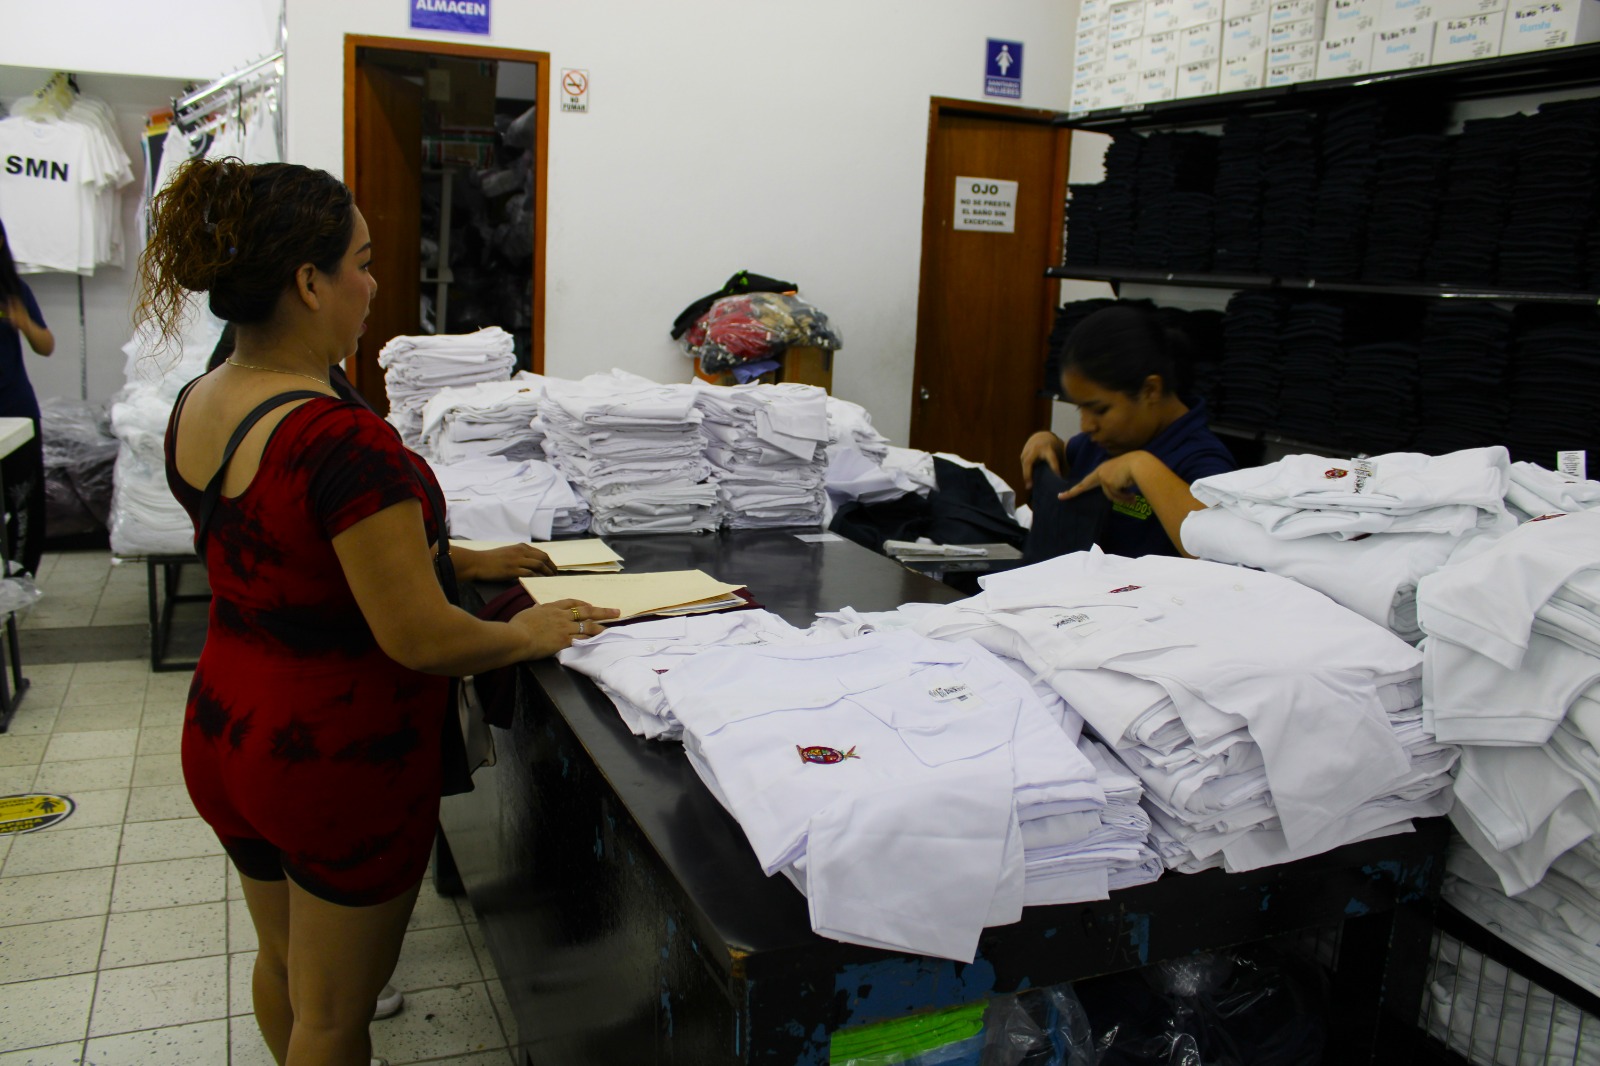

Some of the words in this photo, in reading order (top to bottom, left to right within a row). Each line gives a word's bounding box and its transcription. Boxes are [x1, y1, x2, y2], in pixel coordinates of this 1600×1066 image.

[416, 0, 486, 16] ALMACEN
[986, 86, 1020, 96] MUJERES
[5, 154, 69, 182] SMN
[971, 183, 999, 195] OJO
[984, 200, 1011, 208] PRESTA
[973, 207, 993, 216] BAÑO
